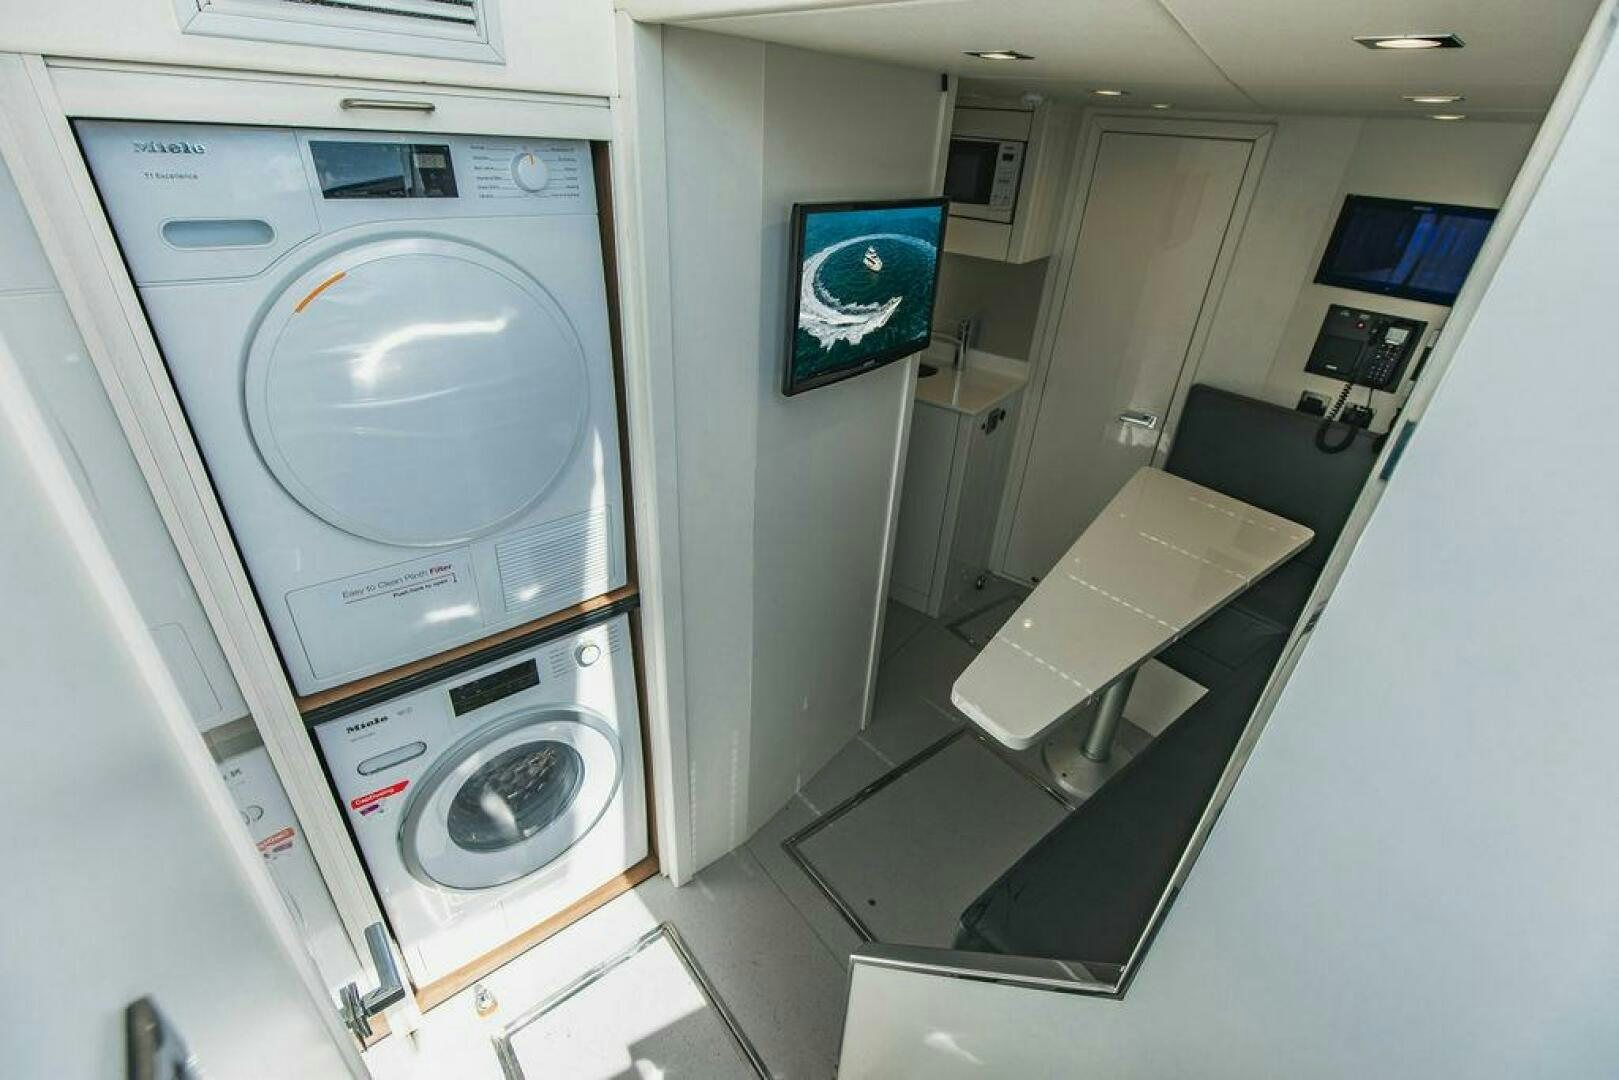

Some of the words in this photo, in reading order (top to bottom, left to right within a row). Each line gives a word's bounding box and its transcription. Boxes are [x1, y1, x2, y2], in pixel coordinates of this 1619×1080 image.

[133, 141, 206, 154] Miele
[343, 589, 364, 598] Easy
[366, 584, 375, 592] to
[377, 577, 403, 589] Clean
[404, 570, 427, 581] Plinth
[429, 564, 452, 575] Filter
[393, 590, 409, 598] Push
[346, 716, 388, 734] Miele
